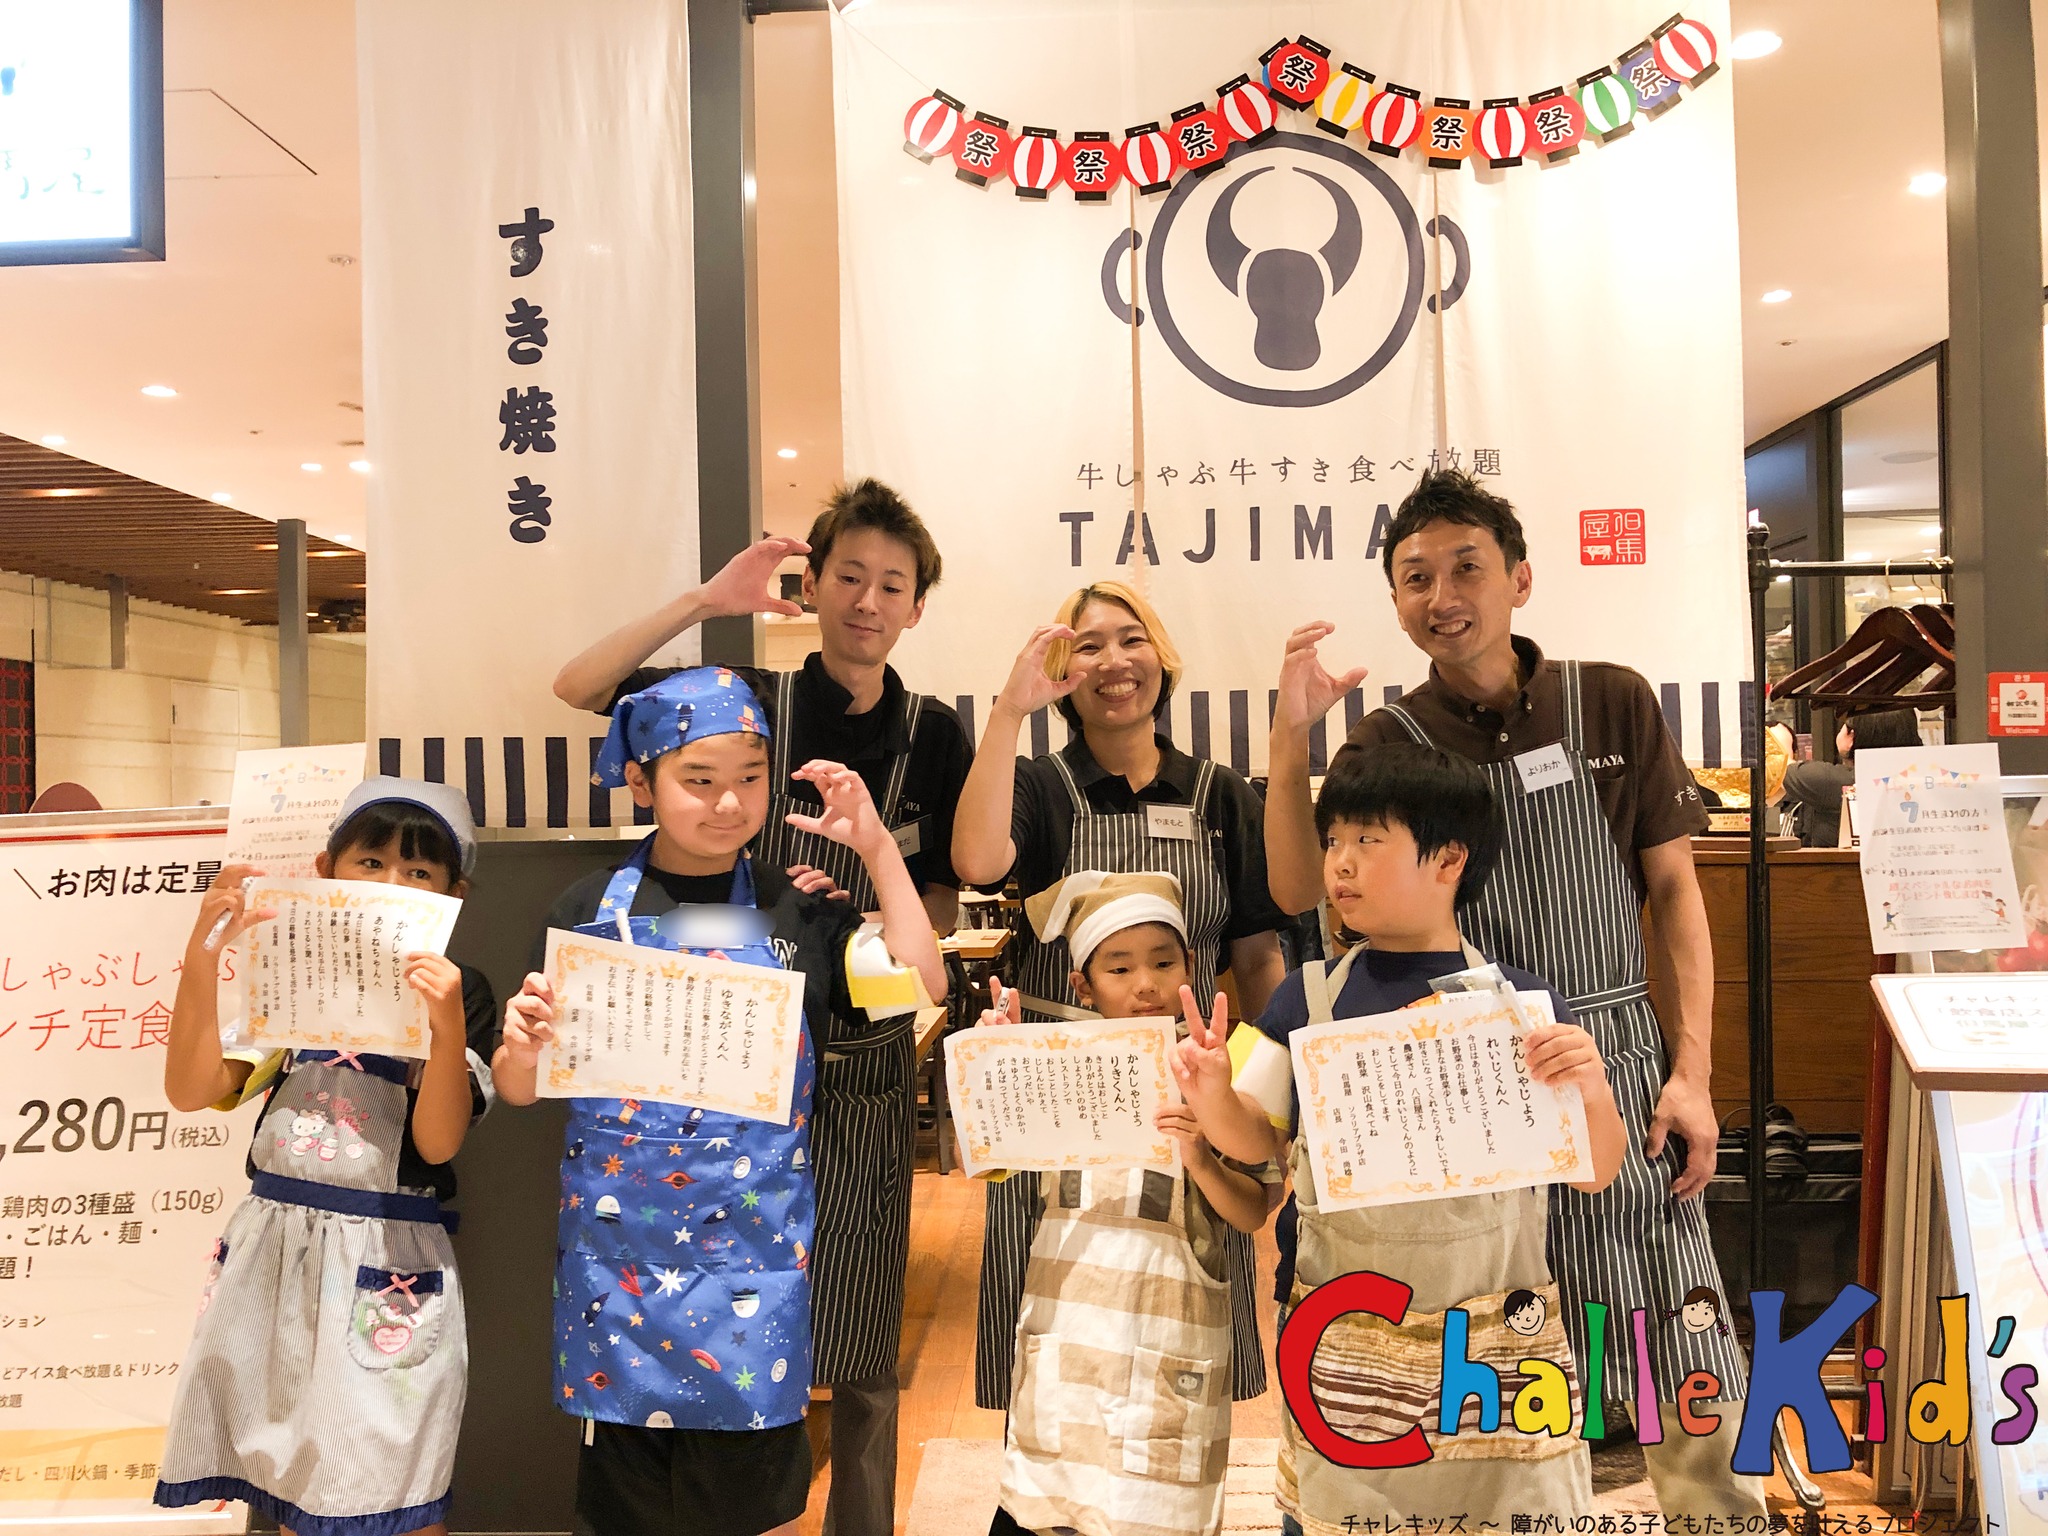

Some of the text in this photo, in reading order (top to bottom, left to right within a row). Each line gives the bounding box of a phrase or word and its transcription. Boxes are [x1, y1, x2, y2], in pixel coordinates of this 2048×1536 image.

[1278, 54, 1316, 92] 祭
[1631, 59, 1669, 99] 祭
[1179, 123, 1217, 160] 祭
[1431, 116, 1466, 150] 祭
[1536, 106, 1573, 143] 祭
[963, 130, 998, 167] 祭
[1074, 150, 1108, 184] 祭
[499, 207, 557, 543] すき焼き
[1078, 447, 1502, 489] 牛しゃぶ牛すき食べ放題
[1527, 760, 1561, 776] よりおか
[47, 861, 222, 898] お肉は定量
[1060, 1057, 1072, 1105] レストランで
[1111, 1055, 1127, 1112] りきくんへ
[1356, 1051, 1379, 1137] お野菜 沢山食べてね
[1371, 1048, 1391, 1123] おしごとをしてます
[1434, 1039, 1456, 1124] 苦手なお野菜少しでも
[1451, 1037, 1472, 1114] お野菜のお仕事して
[1467, 1034, 1496, 1154] 今日はありがとうございました
[1486, 1037, 1510, 1106] れいじくんへ
[1085, 1056, 1102, 1141] ありがとうございました
[1388, 1046, 1418, 1176] そして今日のれいじくんのように
[1418, 1041, 1449, 1176] 好きになってくれたらうれしいです
[0, 1315, 46, 1328] ション
[0, 1462, 161, 1483] だし・四川火鍋・季節
